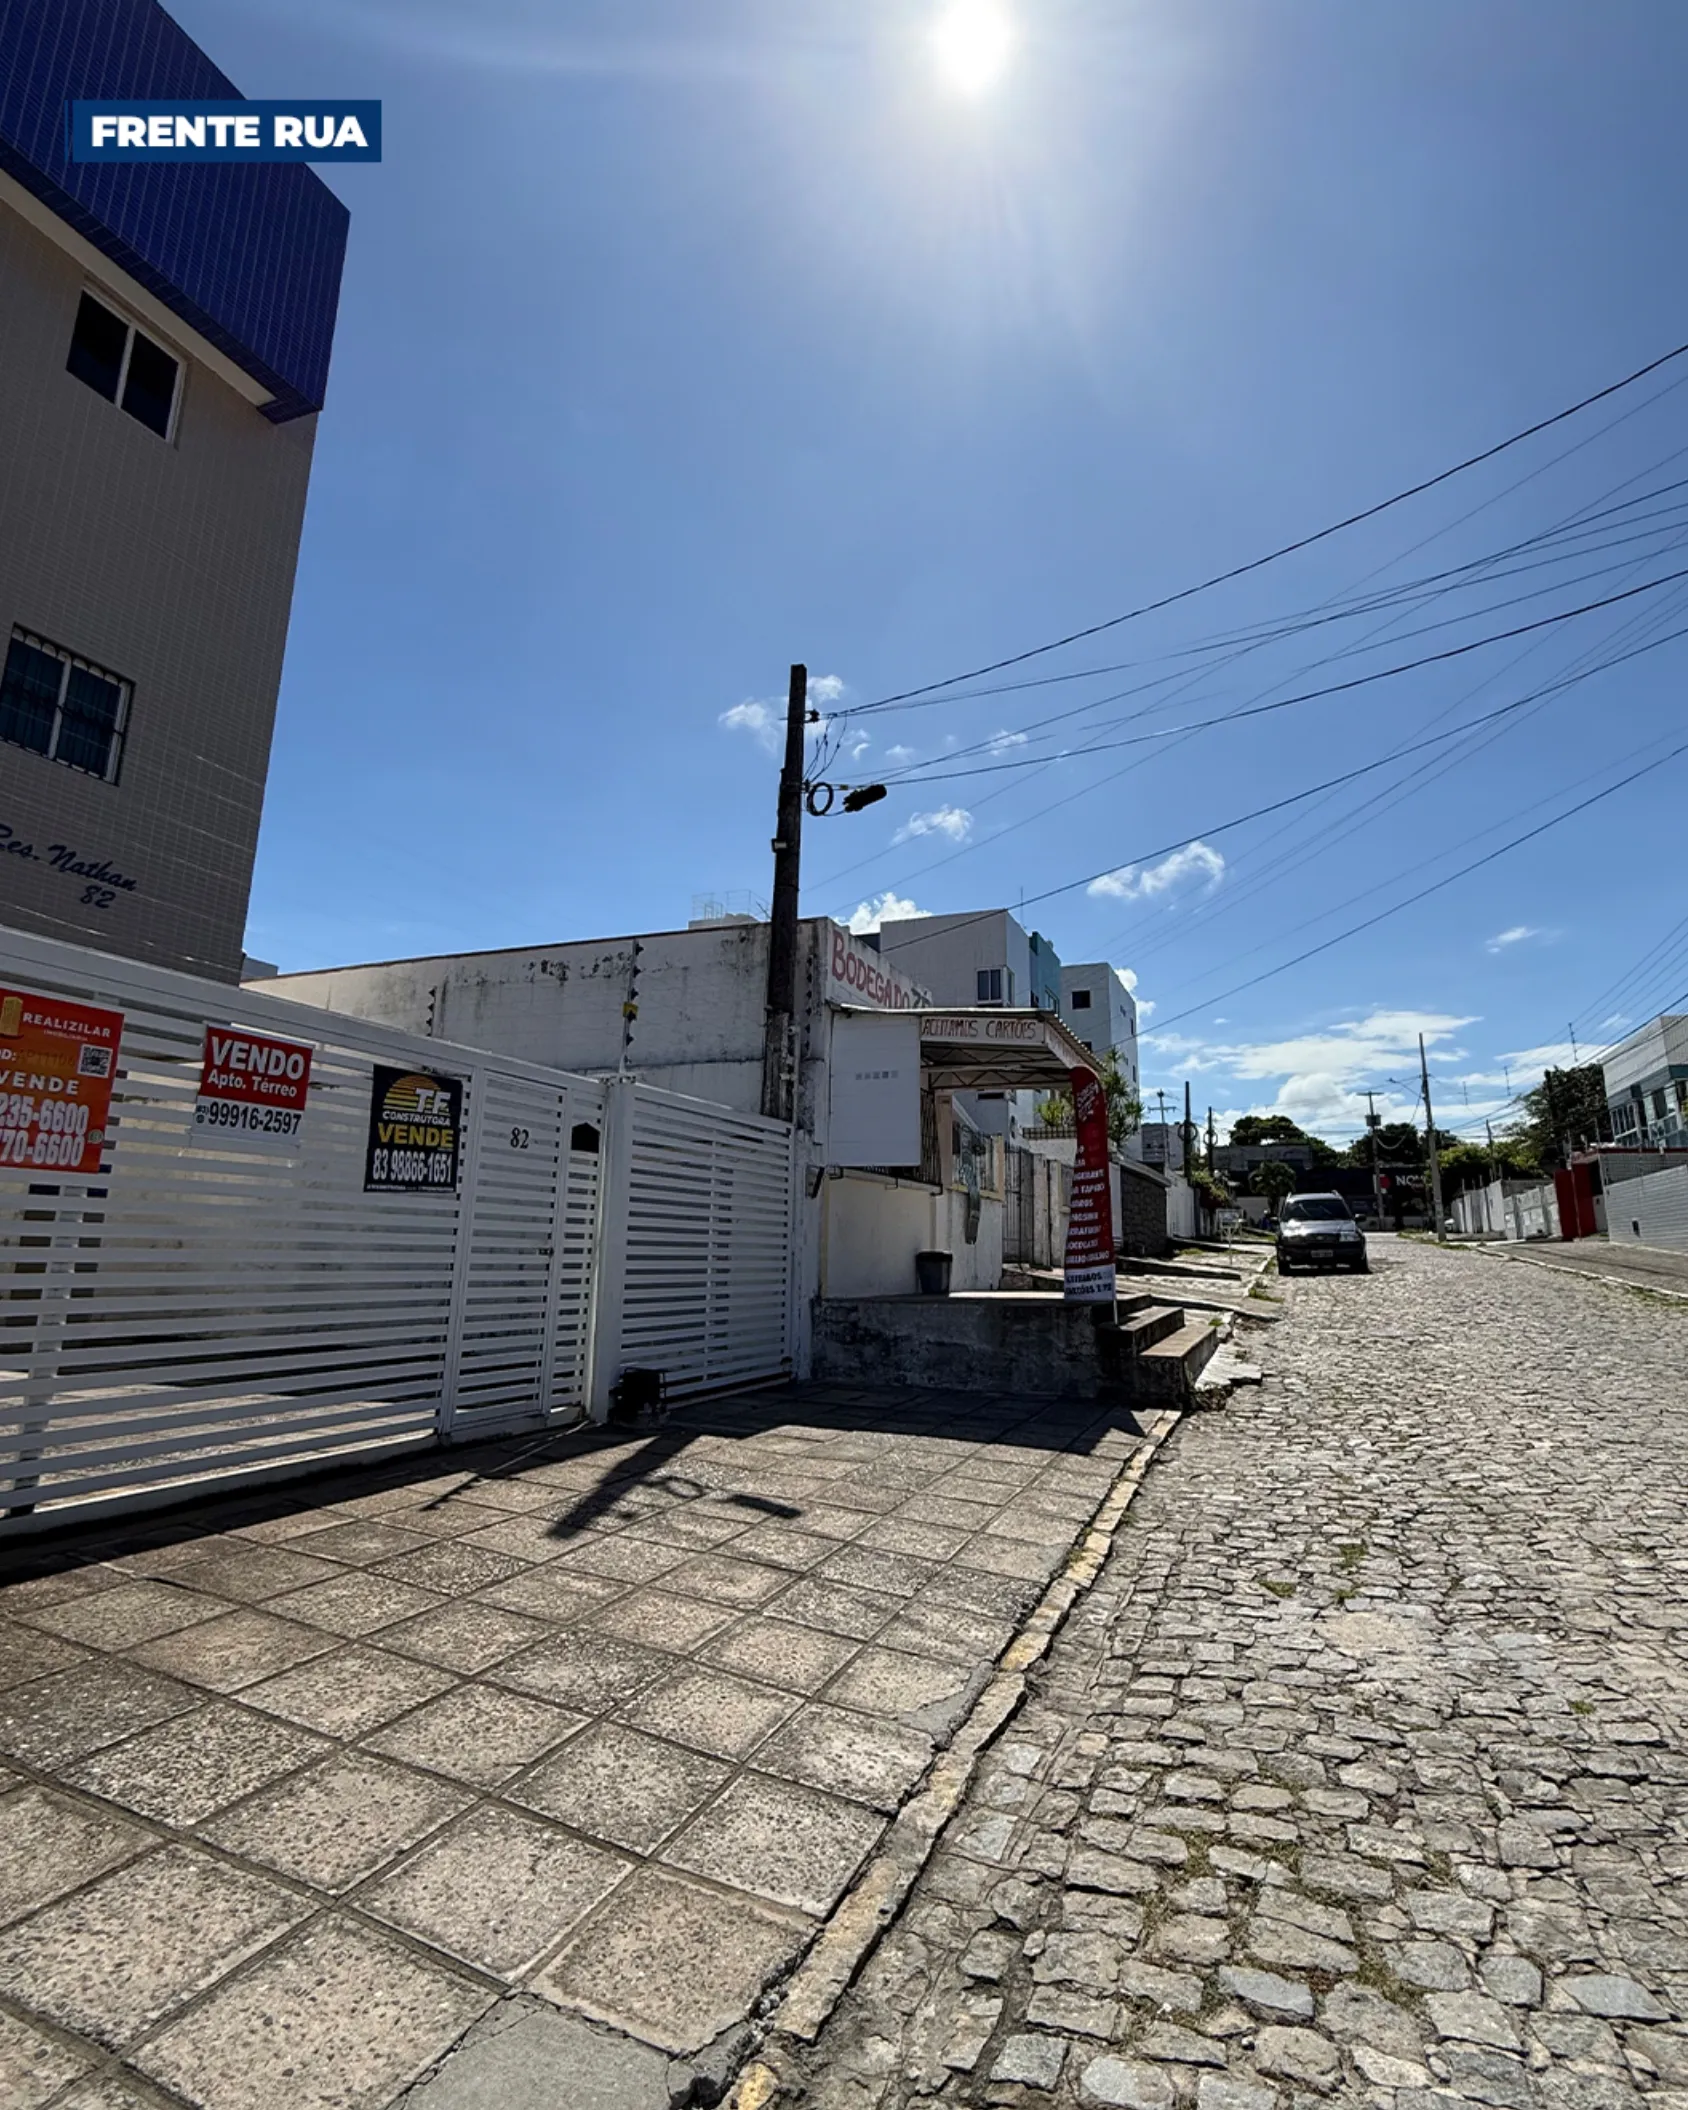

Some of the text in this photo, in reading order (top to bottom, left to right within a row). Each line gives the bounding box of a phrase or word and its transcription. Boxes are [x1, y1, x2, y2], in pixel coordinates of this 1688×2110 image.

[48, 844, 137, 891] Nathan
[80, 885, 116, 909] 82
[832, 930, 893, 1009] BODEGA
[22, 1012, 111, 1038] REALIZILAR
[211, 1036, 305, 1081] VENDO
[207, 1069, 298, 1098] Apto. Térreo
[415, 1087, 451, 1114] TF
[208, 1101, 302, 1135] 99916-2597
[382, 1110, 451, 1127] CONSTRUTORA
[378, 1122, 454, 1149] VENDE
[510, 1127, 530, 1149] 82
[373, 1148, 453, 1183] 83 98866-1651
